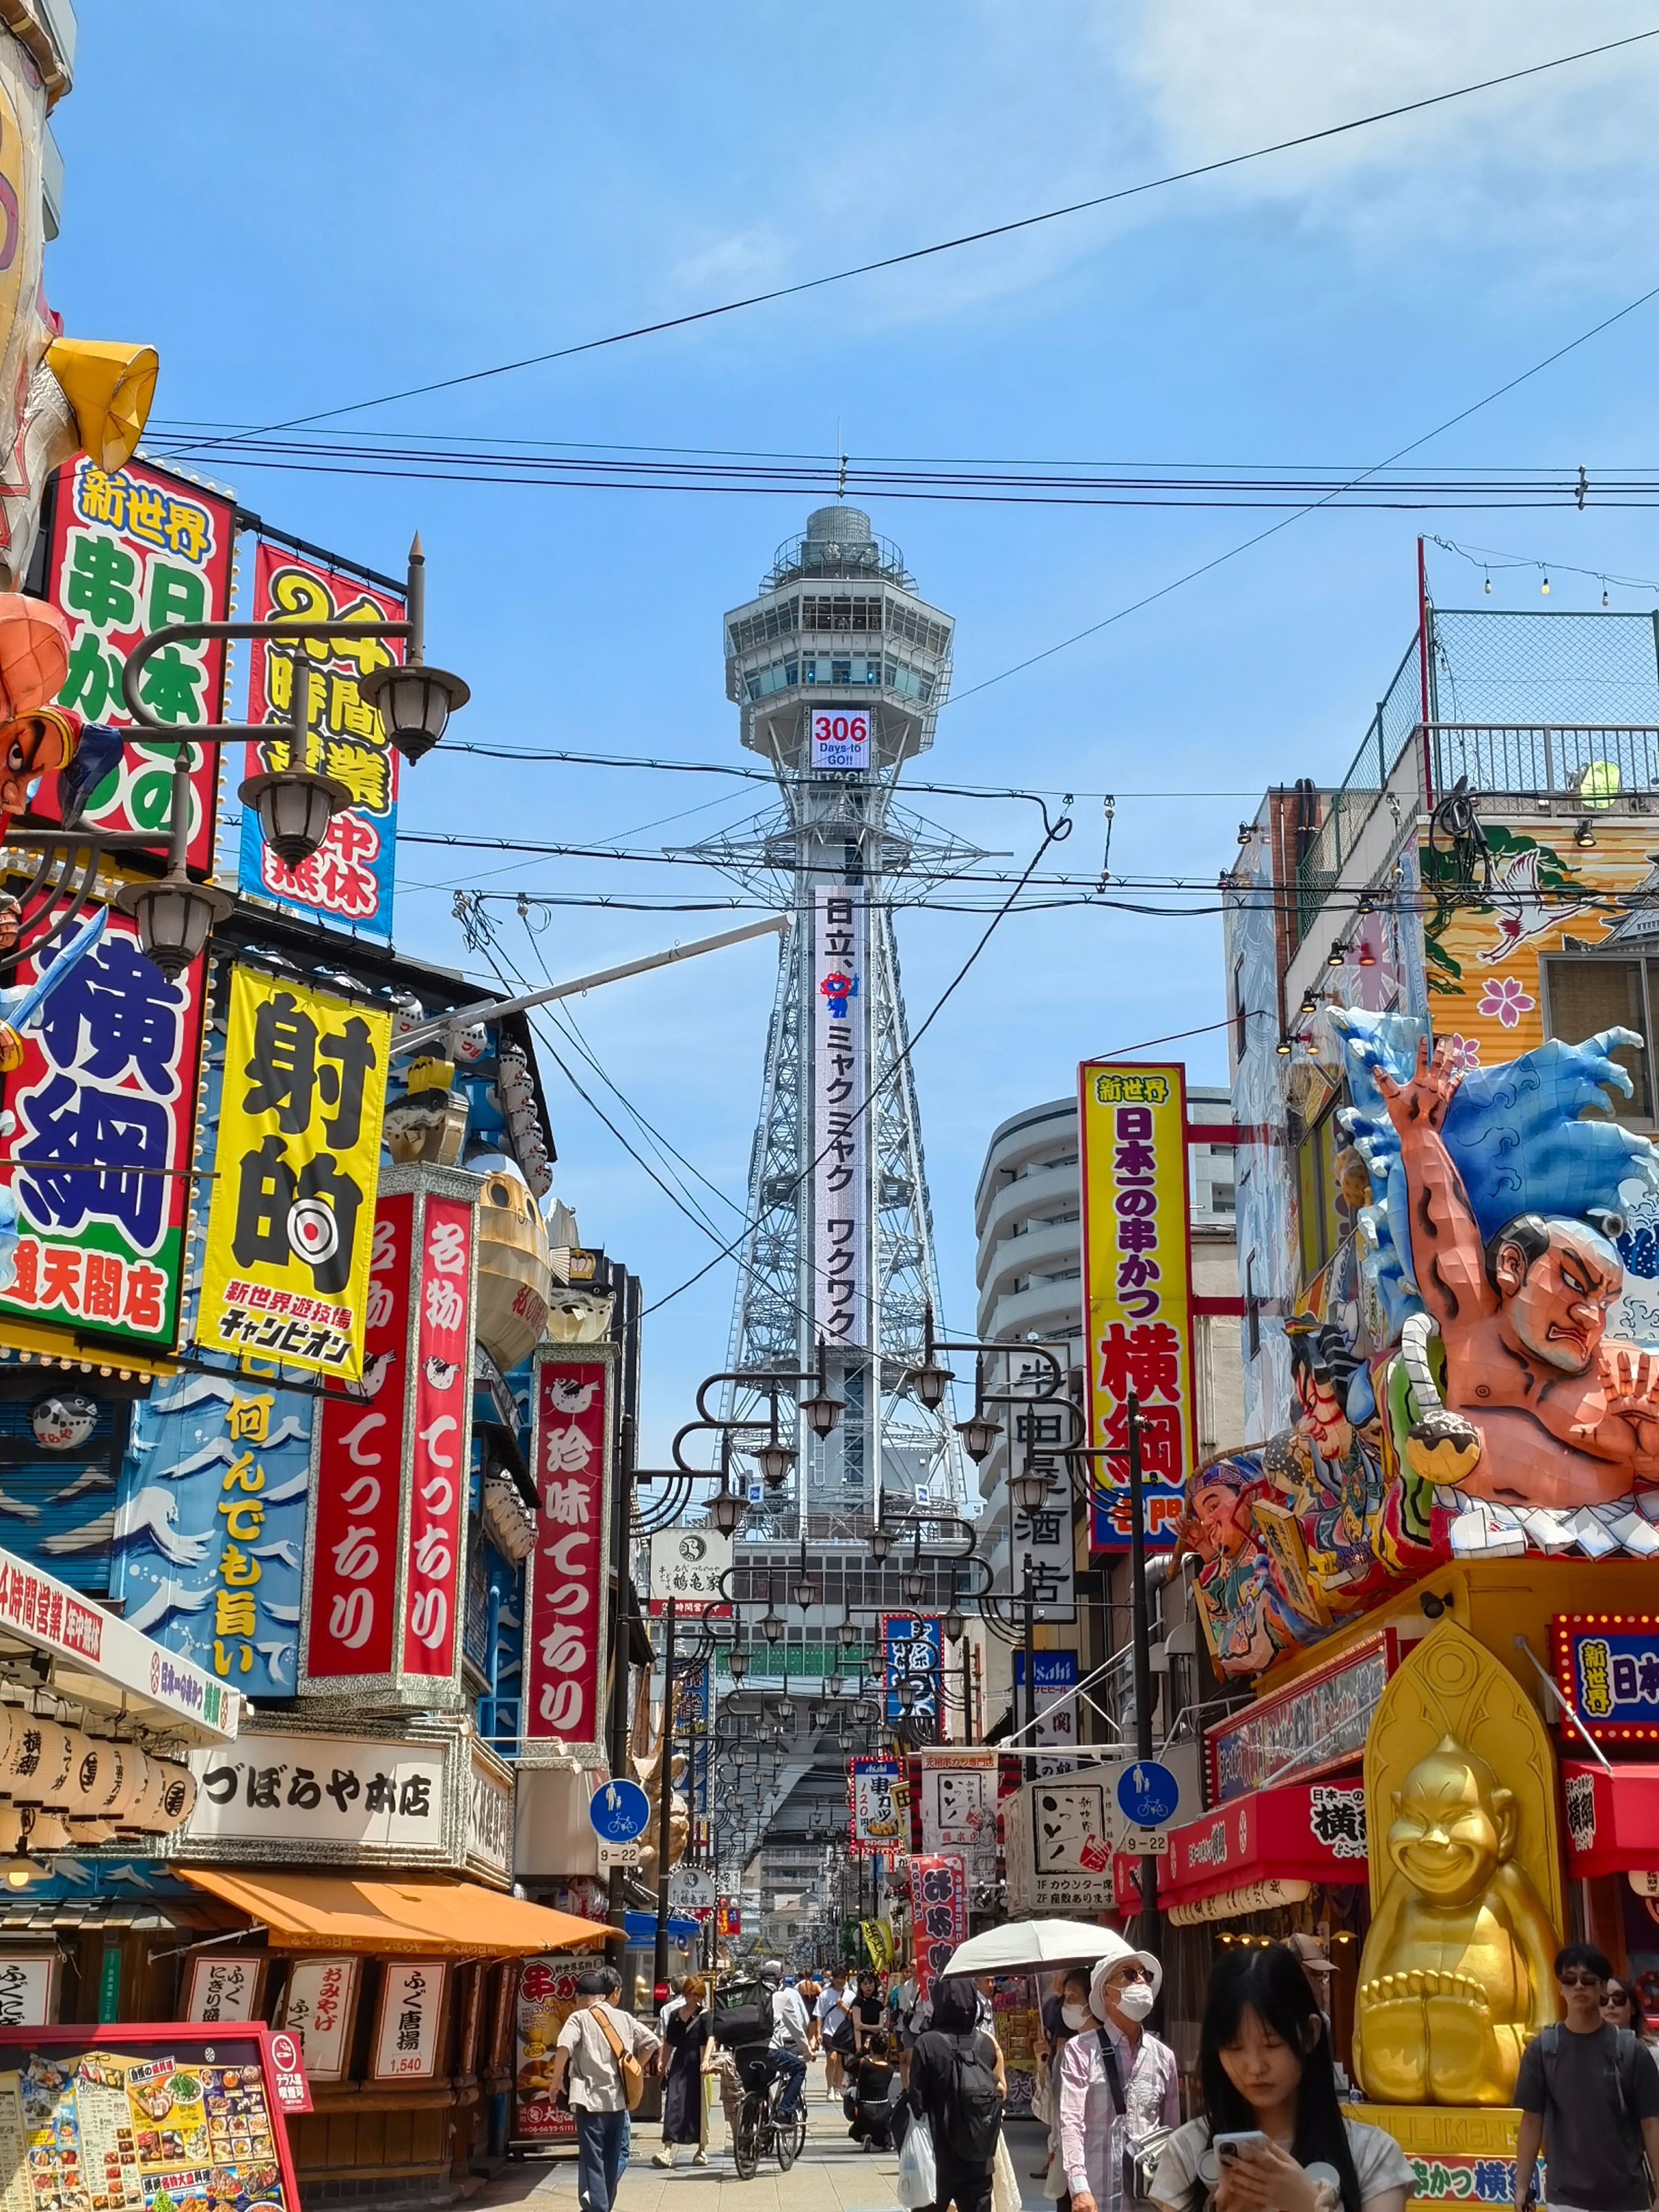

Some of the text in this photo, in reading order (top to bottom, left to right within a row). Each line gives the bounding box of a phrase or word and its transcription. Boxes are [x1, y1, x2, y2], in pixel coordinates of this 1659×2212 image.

[80, 464, 209, 562] 新世界
[814, 716, 867, 742] 306
[820, 742, 861, 753] Days to
[827, 755, 853, 765] GO!!
[19, 920, 185, 1249] 横綱
[825, 1024, 854, 1194] ミャクミャク
[1098, 1076, 1168, 1104] 新世界
[231, 992, 376, 1293] 射的
[1114, 1106, 1161, 1320] 日本一の串かつ
[225, 1280, 353, 1330] 新世界遊技場
[426, 1221, 465, 1331] 名物
[825, 1218, 855, 1338] ワクワク
[218, 1311, 355, 1364] チャンピオン
[1101, 1323, 1183, 1485] 横綱
[214, 1395, 274, 1676] 何んでも旨い
[329, 1412, 386, 1649] てっちり
[410, 1414, 458, 1649] てっちり
[539, 1424, 593, 1730] 珍味てっちり
[1584, 1642, 1609, 1714] 新世界
[203, 1763, 433, 1819] づぼらや本店
[870, 1775, 892, 1823] 串カツ
[1313, 1788, 1365, 1801] 日本一の
[225, 1965, 245, 2005] ふぐ
[315, 1967, 342, 2032] おみやげ
[397, 1970, 427, 2051] ふぐ唐揚
[522, 1963, 577, 2002] 串か
[389, 2056, 422, 2074] 1,540
